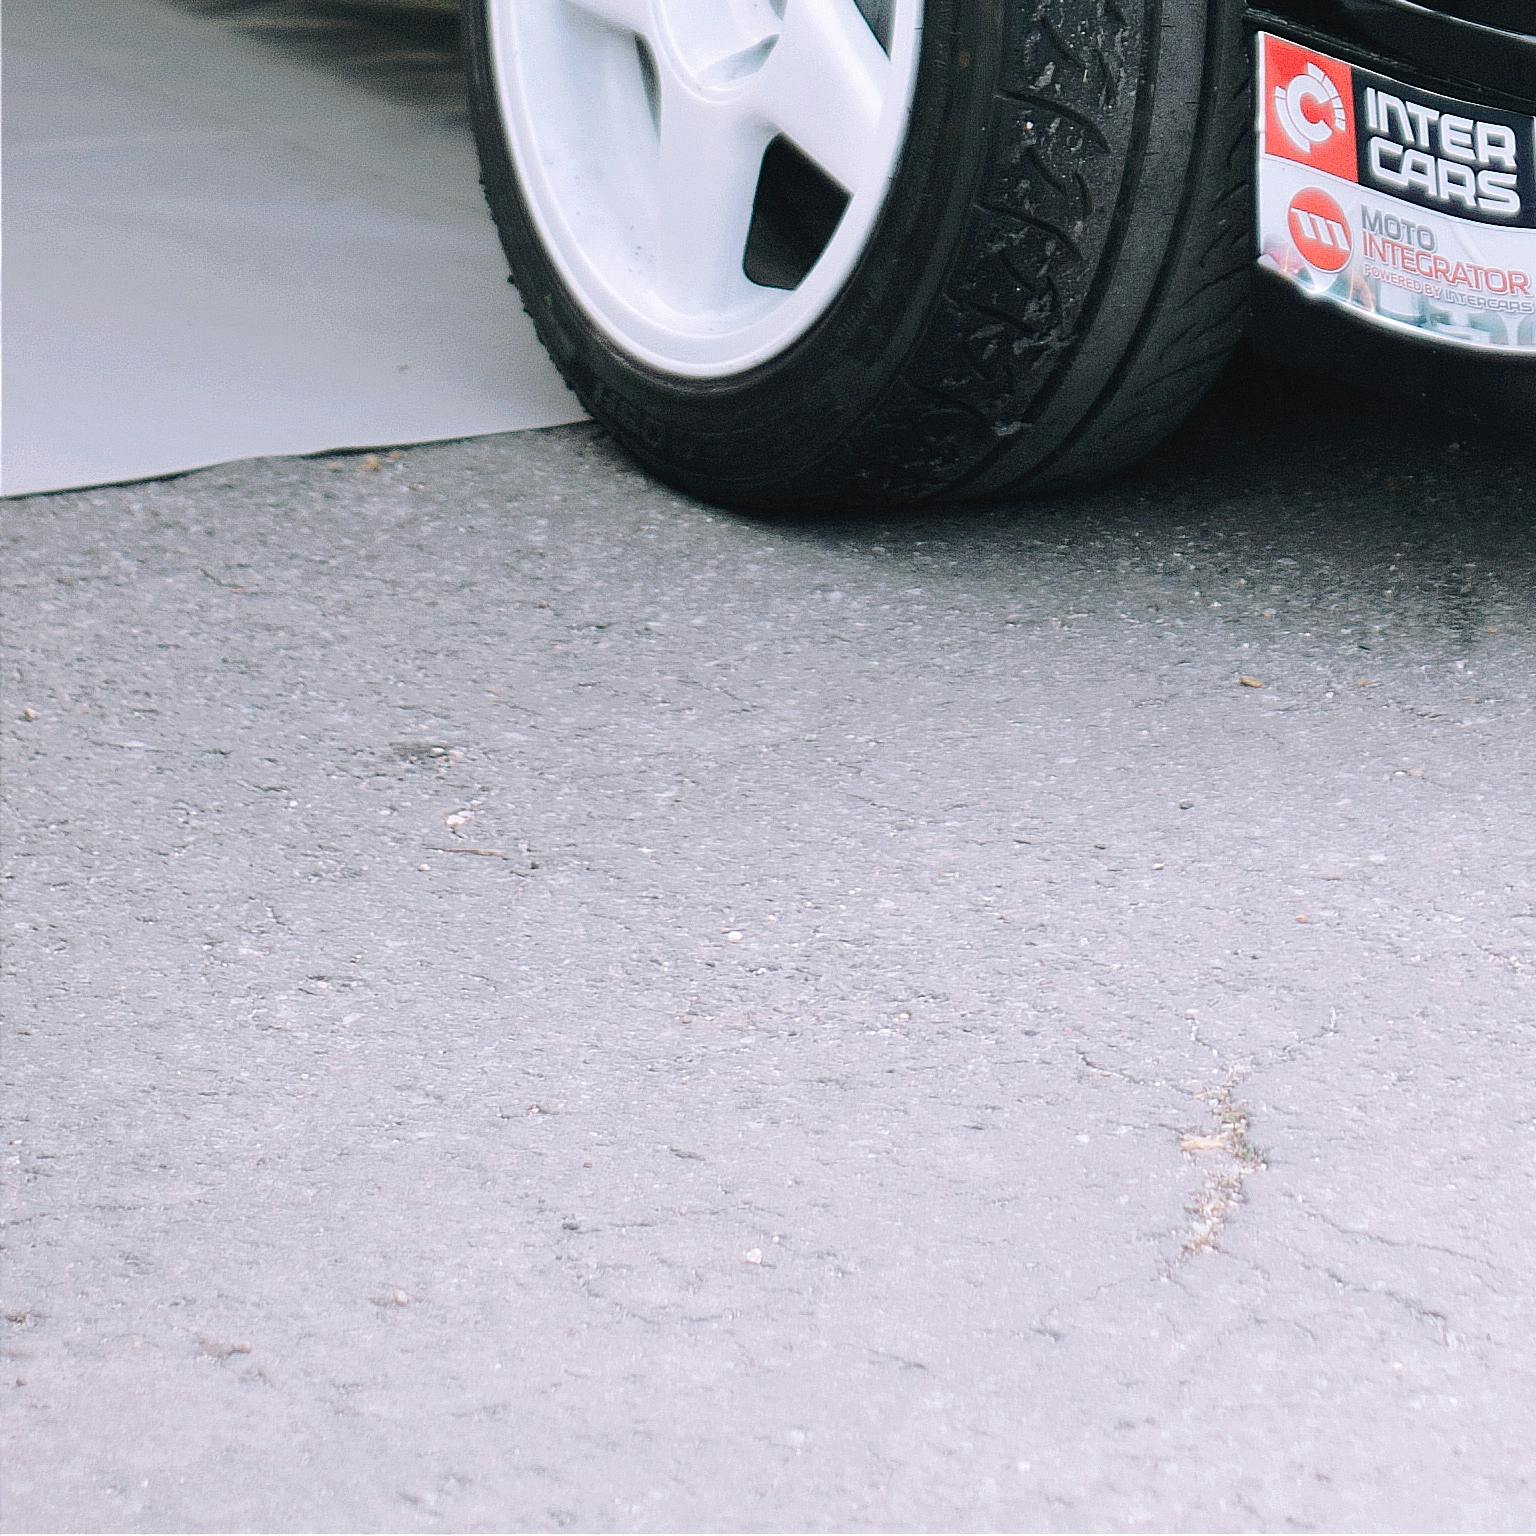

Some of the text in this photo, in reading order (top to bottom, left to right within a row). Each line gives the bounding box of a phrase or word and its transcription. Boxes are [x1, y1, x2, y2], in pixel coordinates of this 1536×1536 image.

[1366, 85, 1517, 170] INTER
[1369, 135, 1521, 216] CARS
[1361, 204, 1435, 251] MOTO
[1362, 231, 1534, 297] INTEGRATOR
[1363, 263, 1422, 293] POWERED
[1423, 284, 1442, 299] BY
